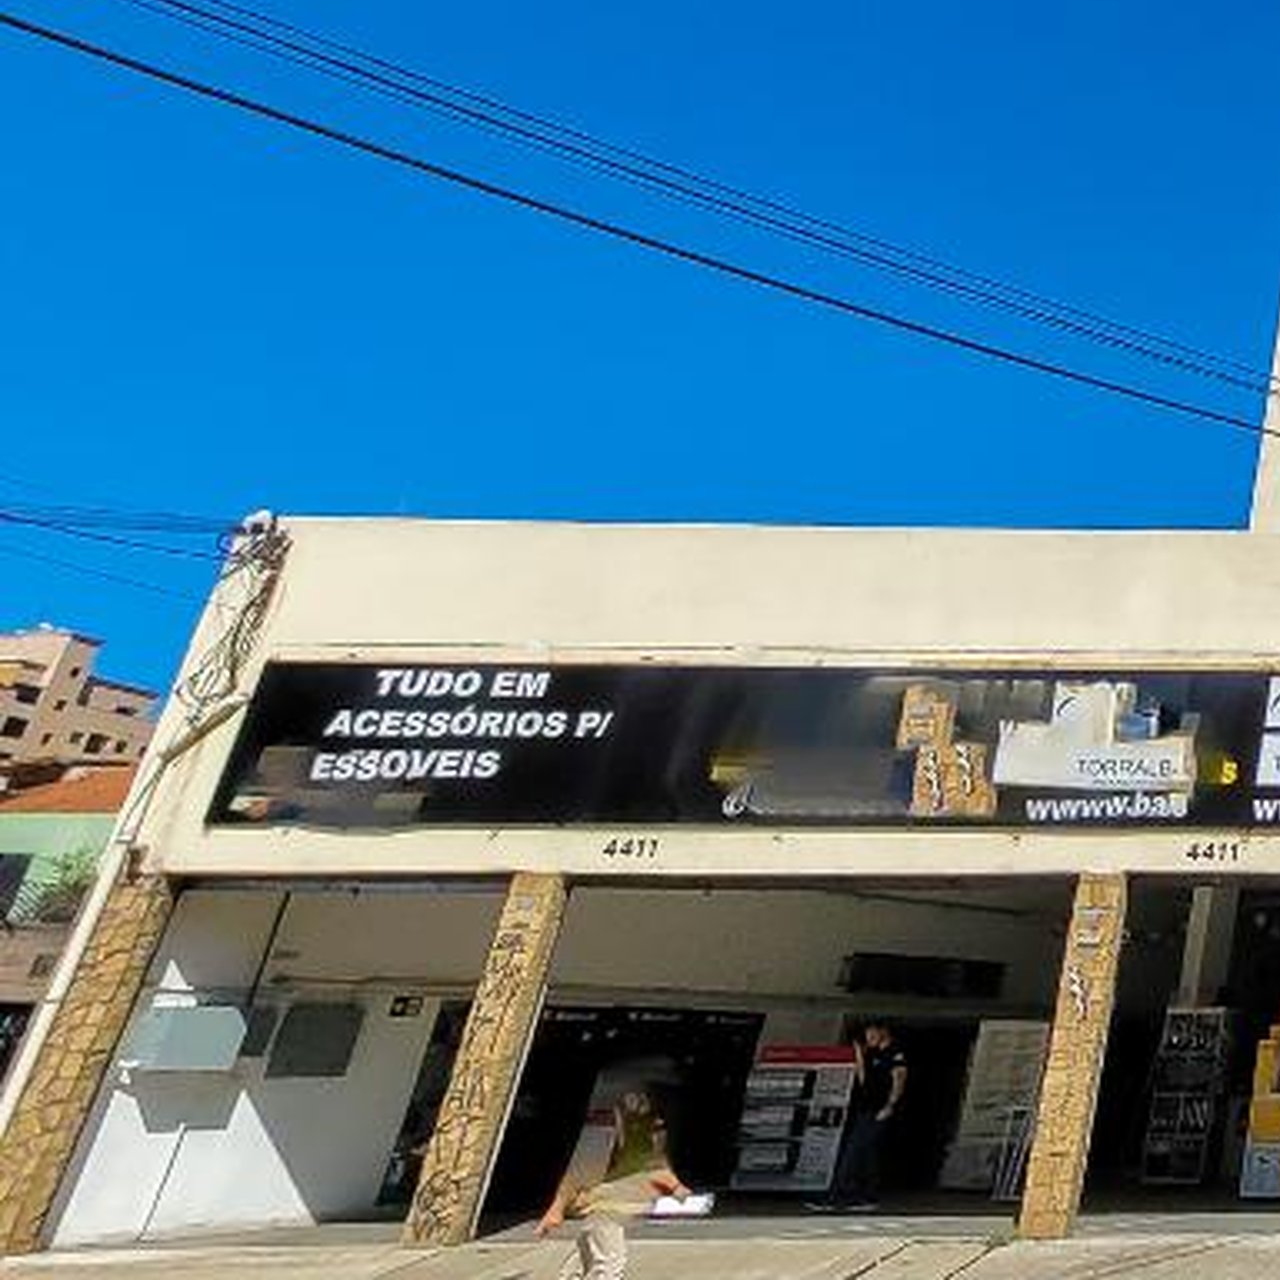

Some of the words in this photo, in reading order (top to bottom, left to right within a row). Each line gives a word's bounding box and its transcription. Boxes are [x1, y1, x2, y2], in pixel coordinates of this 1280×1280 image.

[375, 670, 483, 697] TUDO
[489, 671, 551, 698] EM
[322, 704, 568, 738] ACESSÓRIOS
[573, 711, 614, 738] P/
